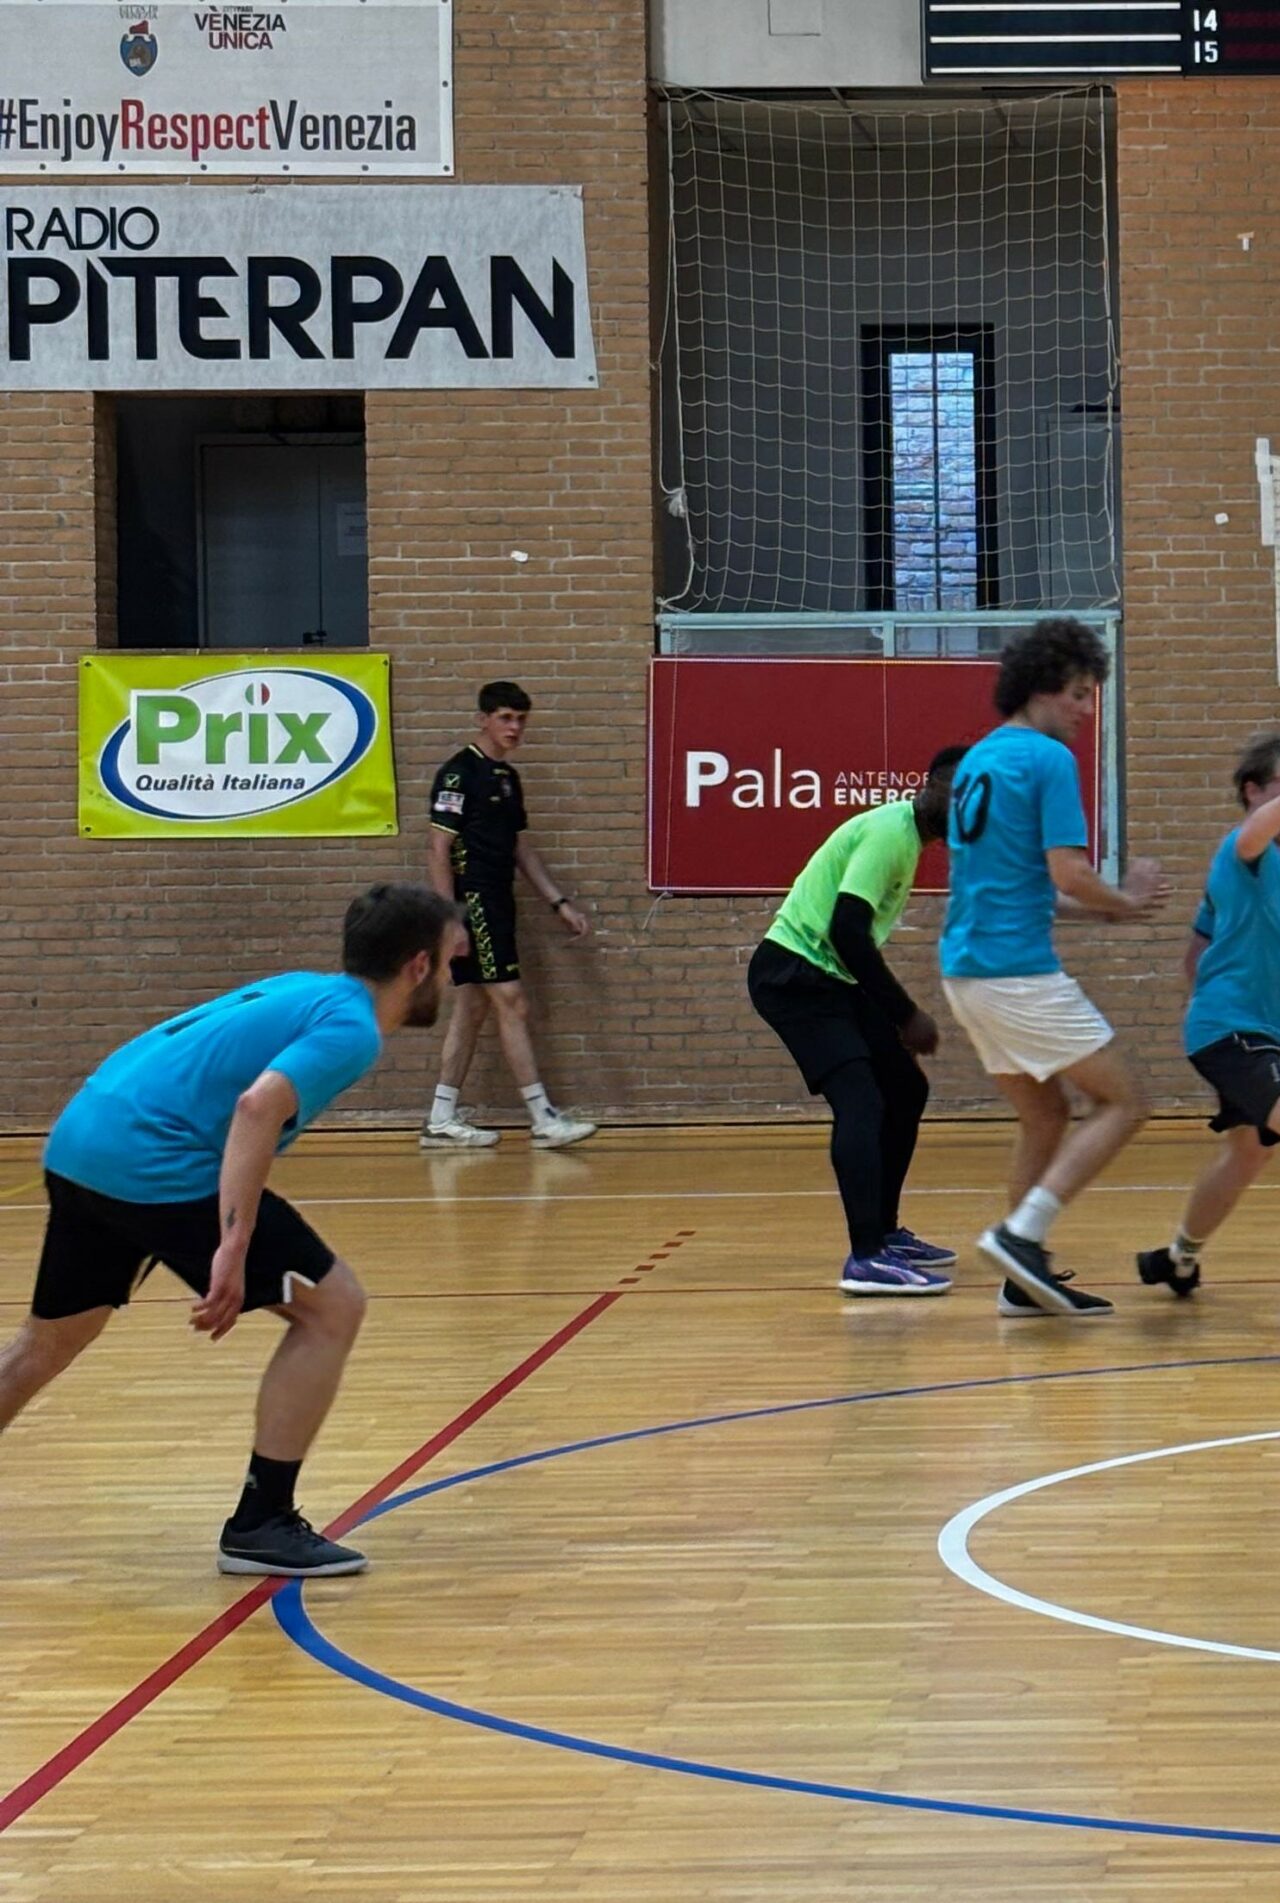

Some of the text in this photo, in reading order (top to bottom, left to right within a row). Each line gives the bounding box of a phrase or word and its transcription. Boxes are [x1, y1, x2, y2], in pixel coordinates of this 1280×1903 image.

[1193, 9, 1218, 32] 14
[208, 32, 274, 50] UNICA
[1194, 41, 1219, 63] 15
[6, 206, 160, 251] RADIO
[8, 256, 575, 361] PITERPAN
[136, 682, 334, 765] Prix
[135, 773, 306, 792] Qualità Italiana
[685, 748, 822, 808] Pala
[834, 771, 930, 787] ANTENOR
[834, 788, 917, 806] ENERG
